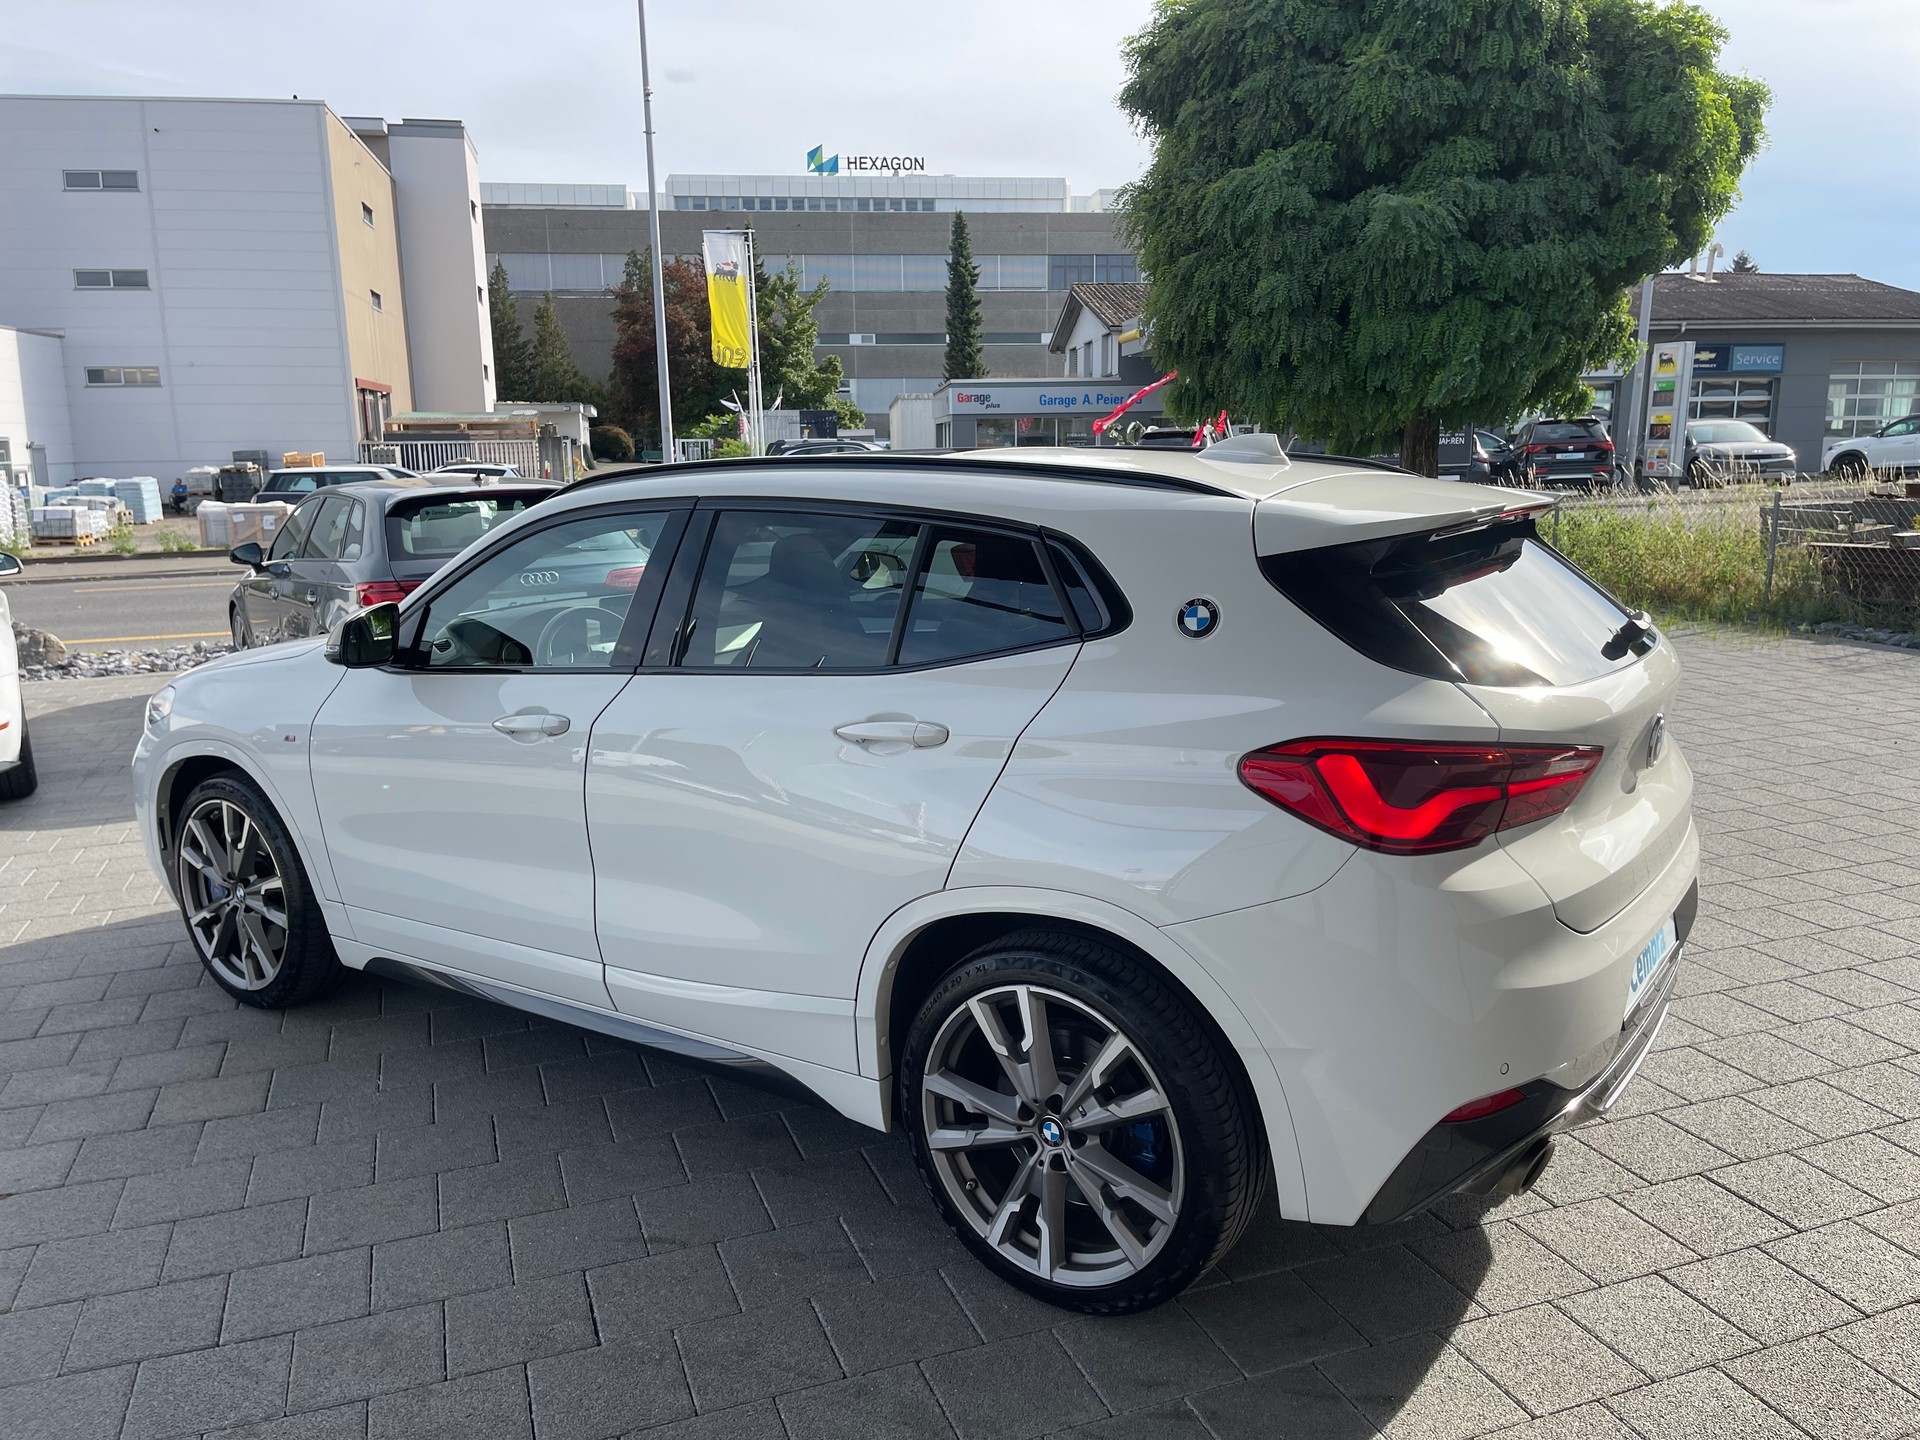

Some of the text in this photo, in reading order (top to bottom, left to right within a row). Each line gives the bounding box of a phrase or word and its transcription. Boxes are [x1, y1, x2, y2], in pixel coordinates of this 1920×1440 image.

[847, 156, 924, 170] HEXAGON
[1736, 353, 1780, 364] Service
[957, 392, 991, 405] Garage
[1039, 394, 1077, 406] Garage
[1082, 394, 1093, 405] A.
[1096, 393, 1124, 405] Peier
[949, 975, 962, 988] 20
[975, 963, 988, 974] XL
